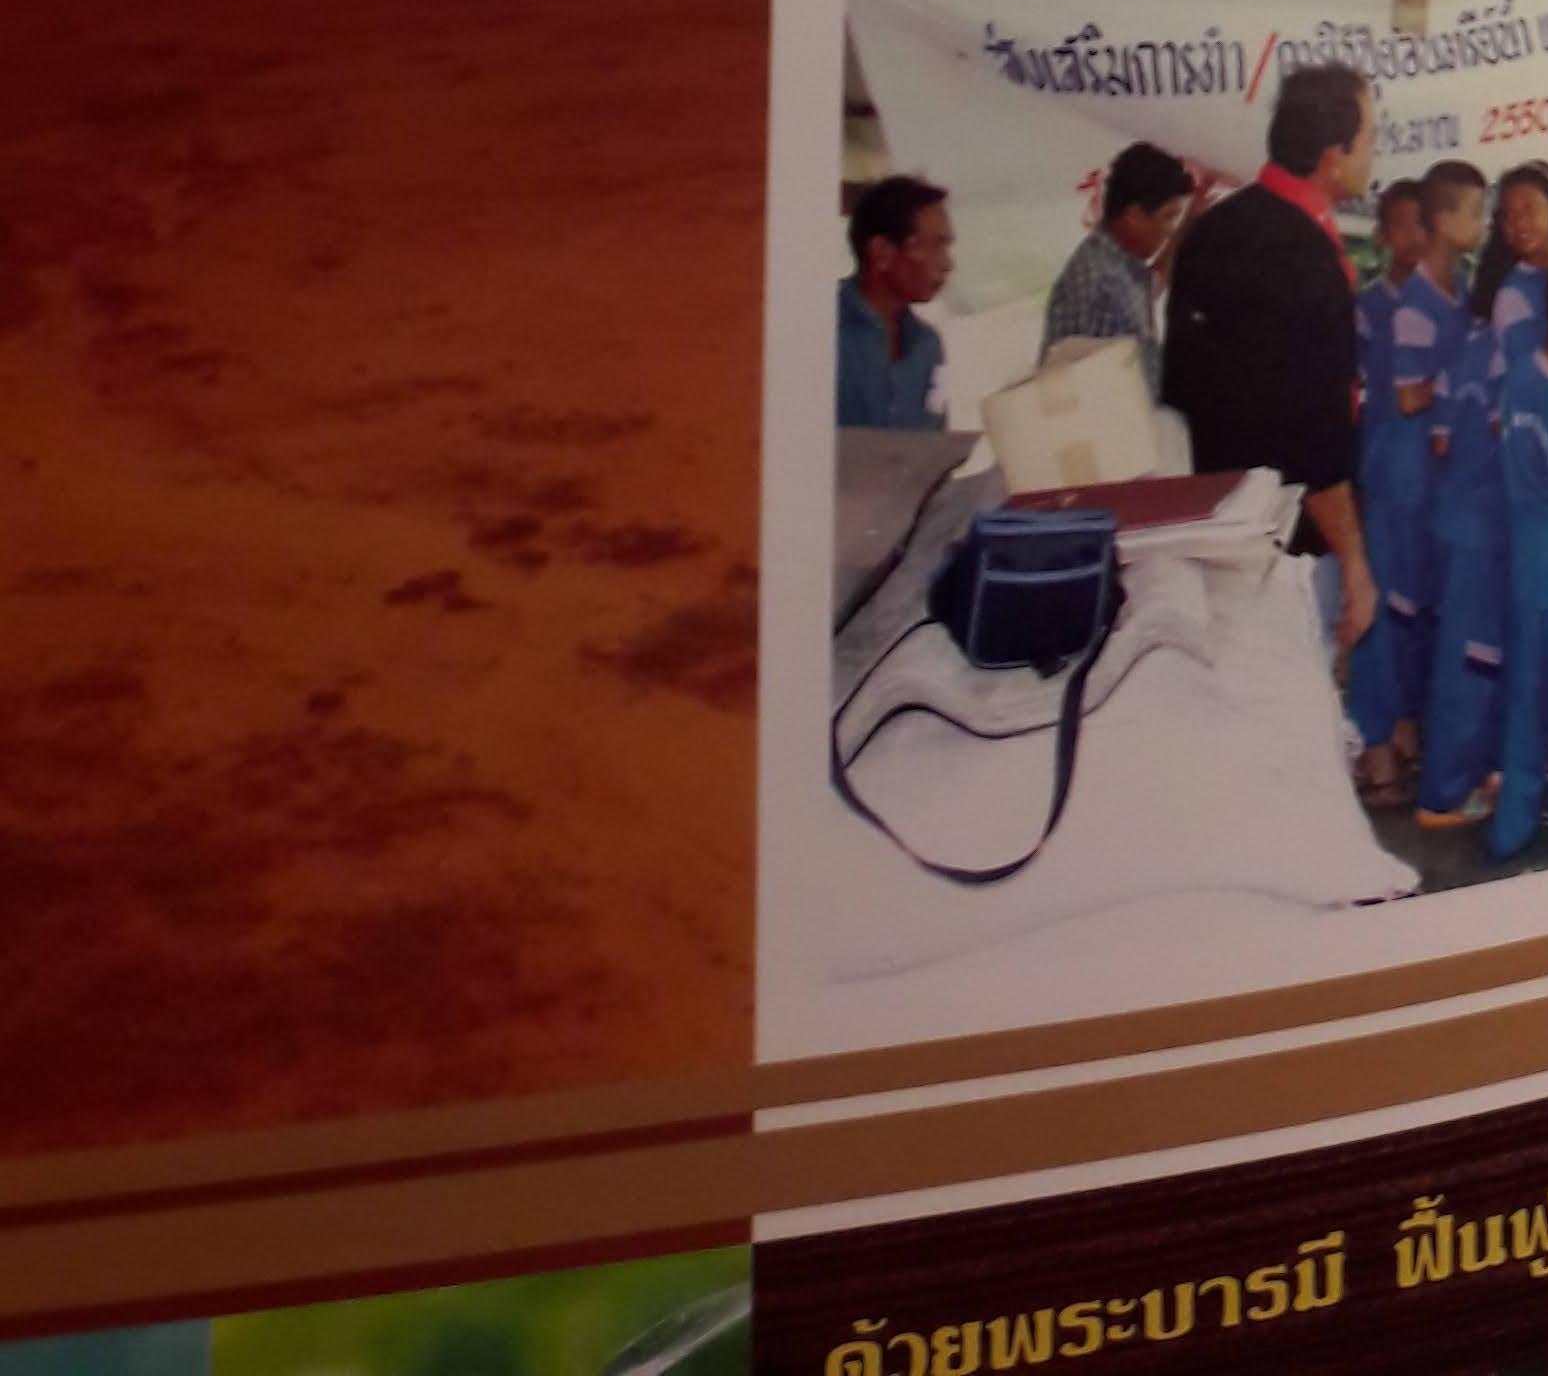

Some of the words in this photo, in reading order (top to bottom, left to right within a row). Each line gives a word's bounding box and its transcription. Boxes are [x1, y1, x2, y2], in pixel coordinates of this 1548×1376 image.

[823, 1230, 1347, 1376] ด้วยพระบารมี
